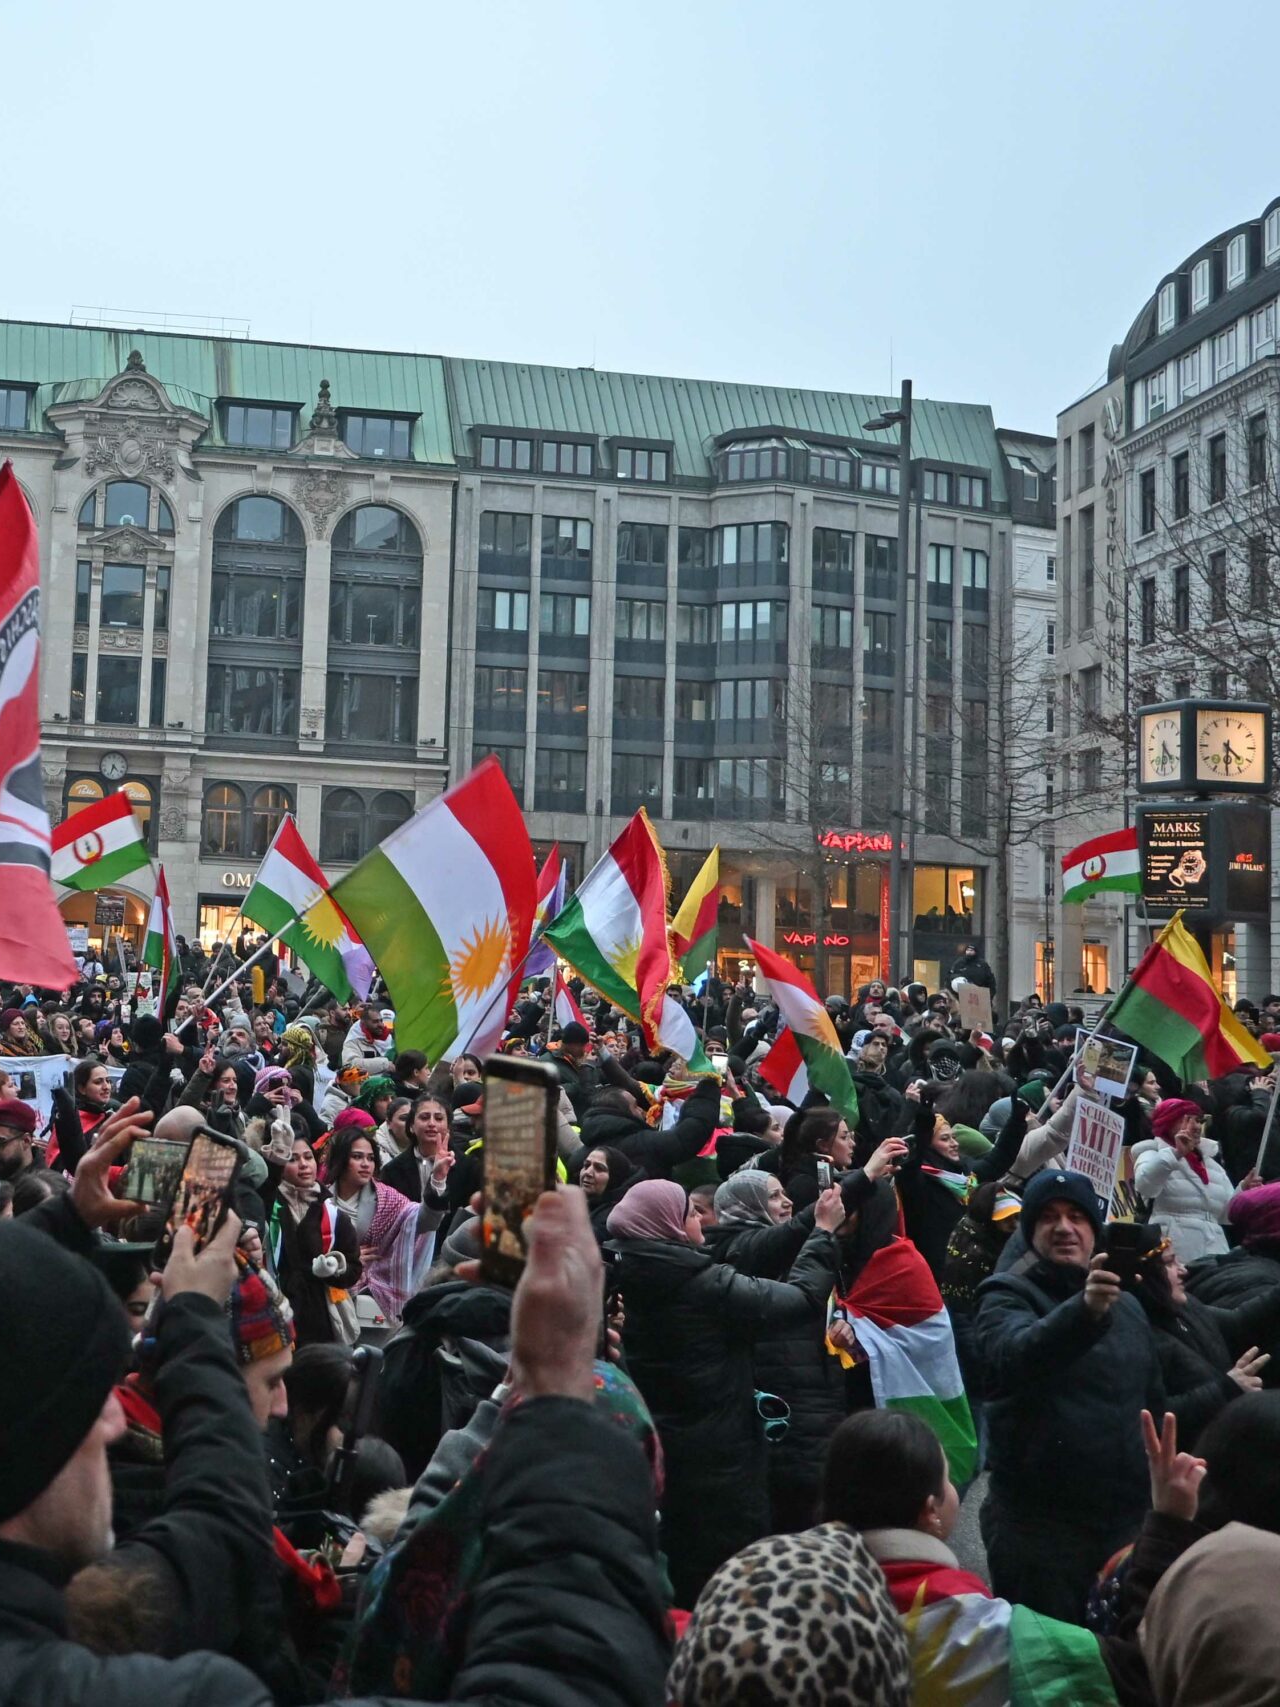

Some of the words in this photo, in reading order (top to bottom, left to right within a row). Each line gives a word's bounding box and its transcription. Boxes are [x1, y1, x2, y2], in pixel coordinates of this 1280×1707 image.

[1153, 822, 1200, 833] MARKS
[1080, 1103, 1122, 1130] SCHLUSS
[1076, 1116, 1121, 1159] MIT
[1070, 1155, 1107, 1183] KRIEG
